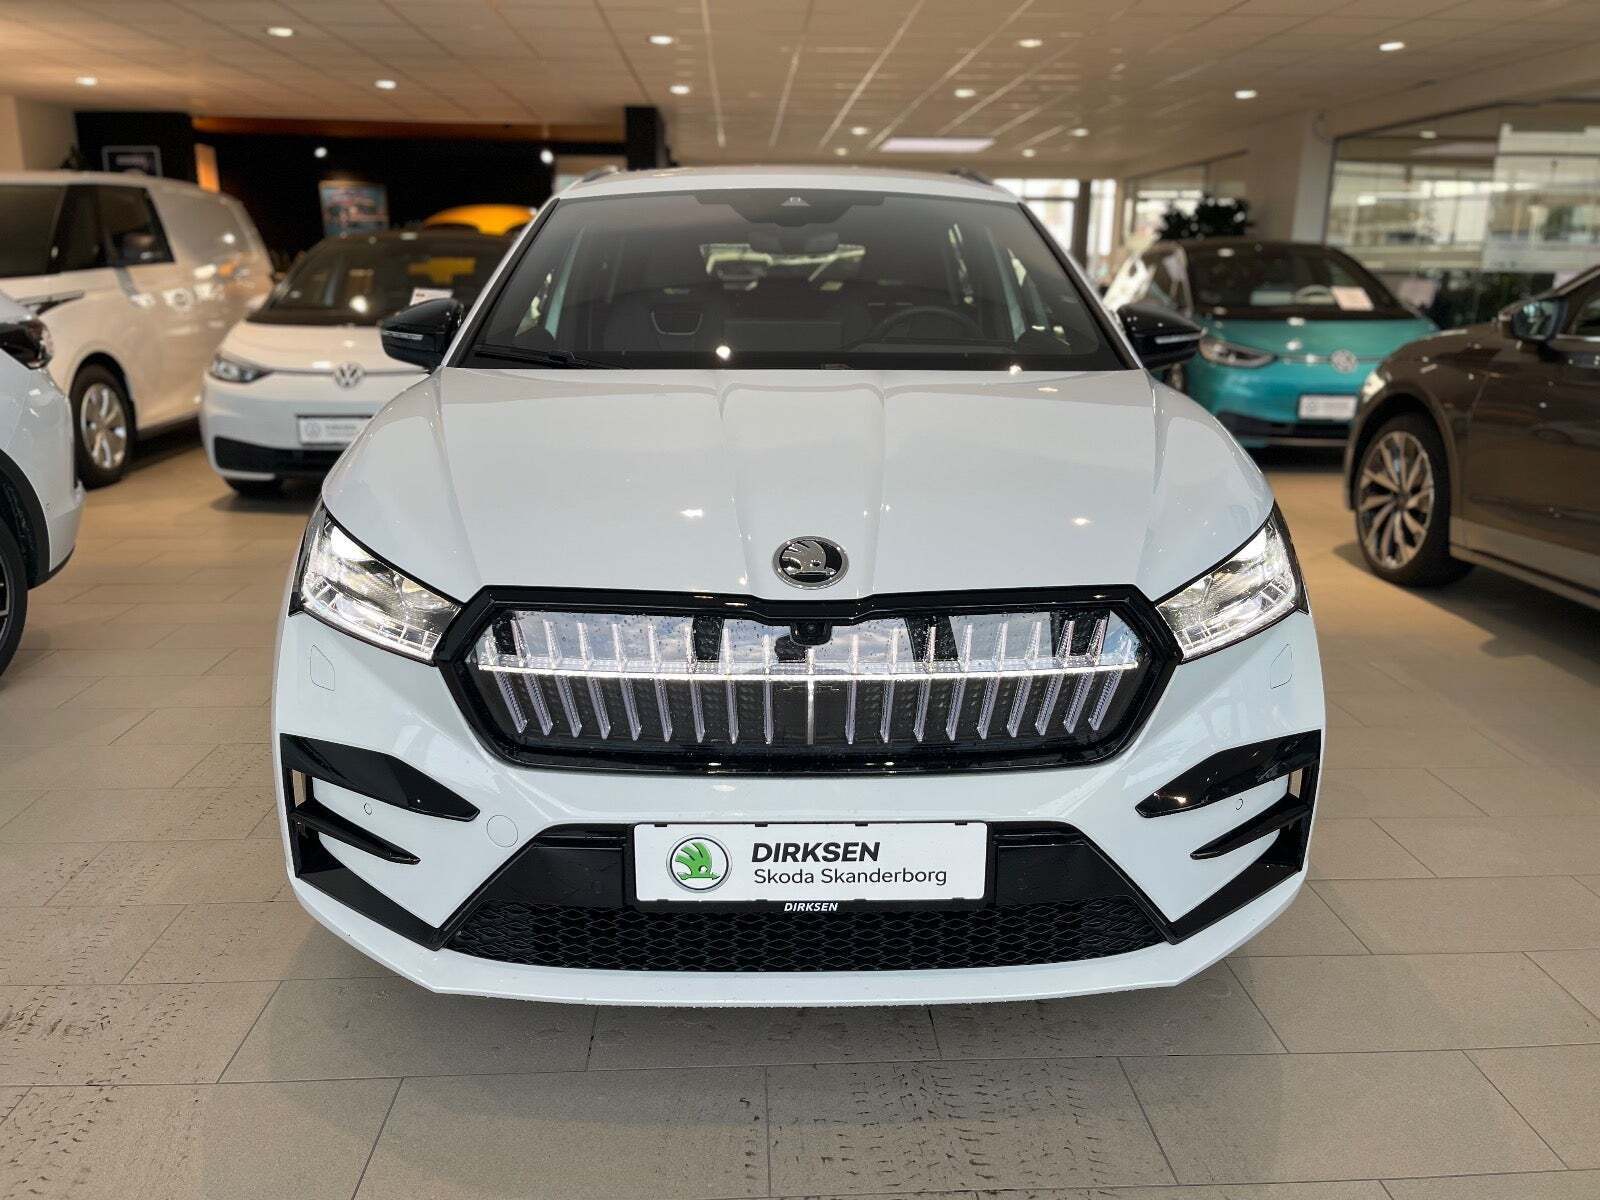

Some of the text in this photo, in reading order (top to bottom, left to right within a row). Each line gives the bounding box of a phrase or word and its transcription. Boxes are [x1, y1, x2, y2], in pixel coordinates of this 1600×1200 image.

[751, 842, 881, 863] DIRKSEN
[754, 867, 947, 886] Skoda Skanderborg
[784, 902, 839, 912] DIRKSEN
